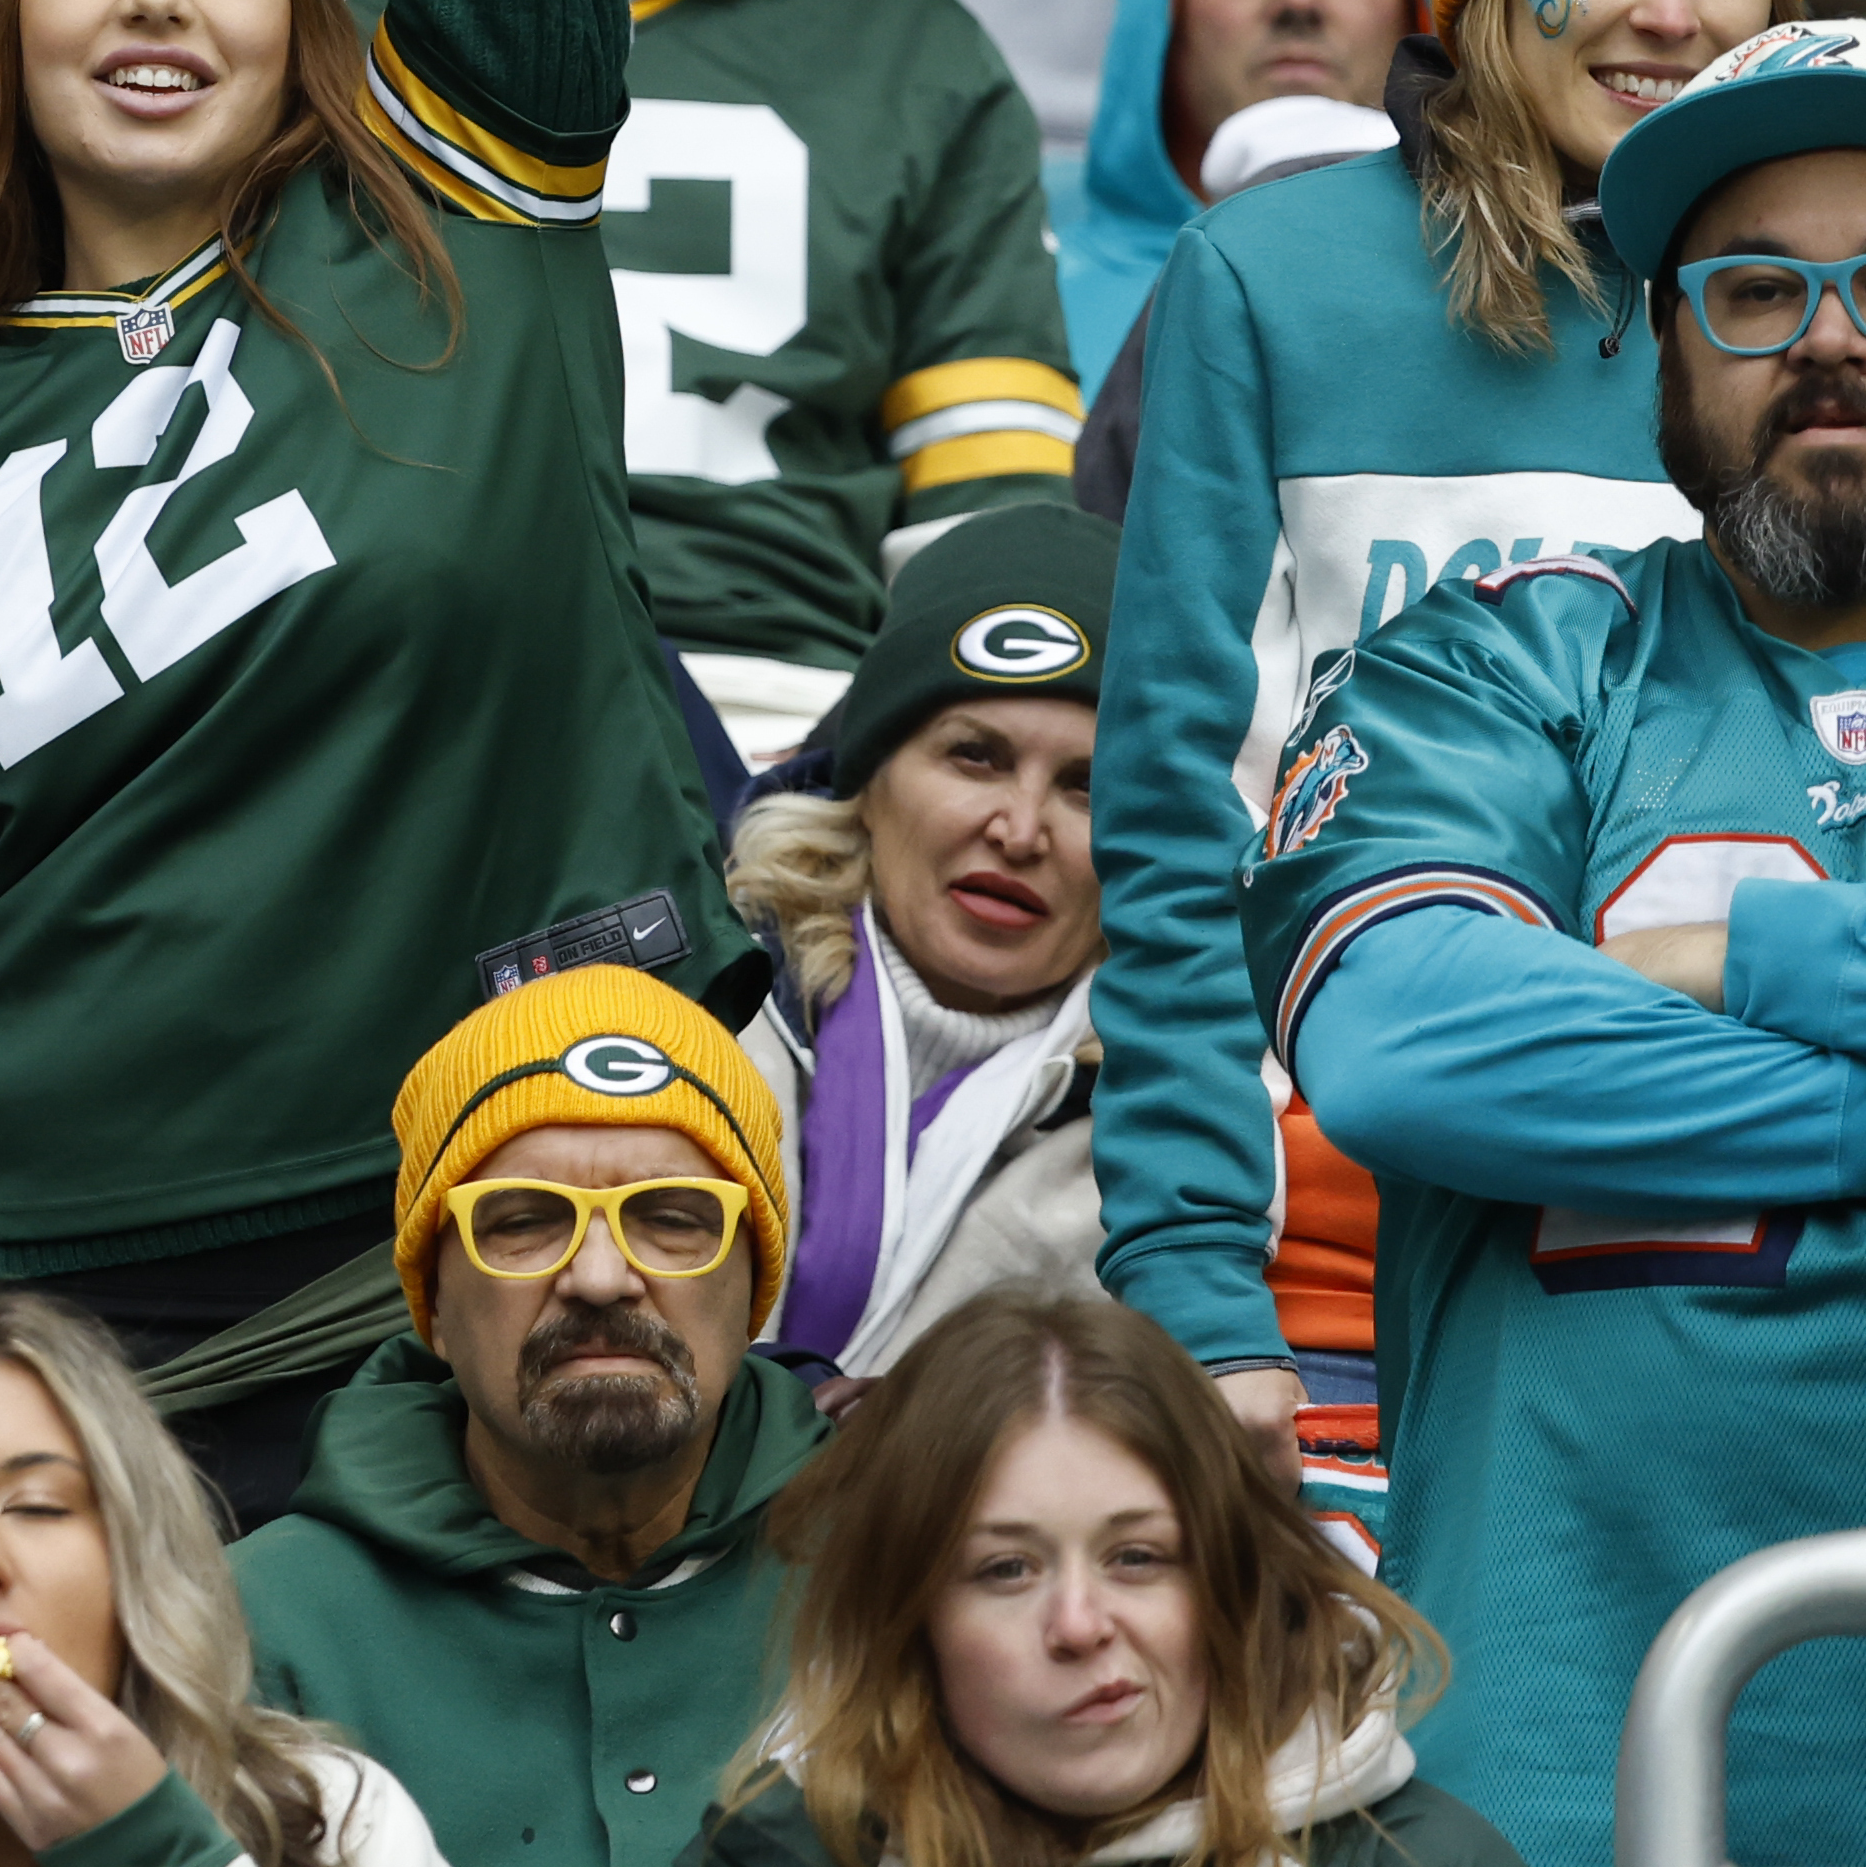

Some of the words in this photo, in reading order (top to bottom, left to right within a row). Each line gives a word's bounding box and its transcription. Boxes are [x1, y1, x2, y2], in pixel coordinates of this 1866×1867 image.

[129, 328, 168, 356] NFL
[581, 929, 623, 955] FIELD
[566, 1035, 670, 1094] G
